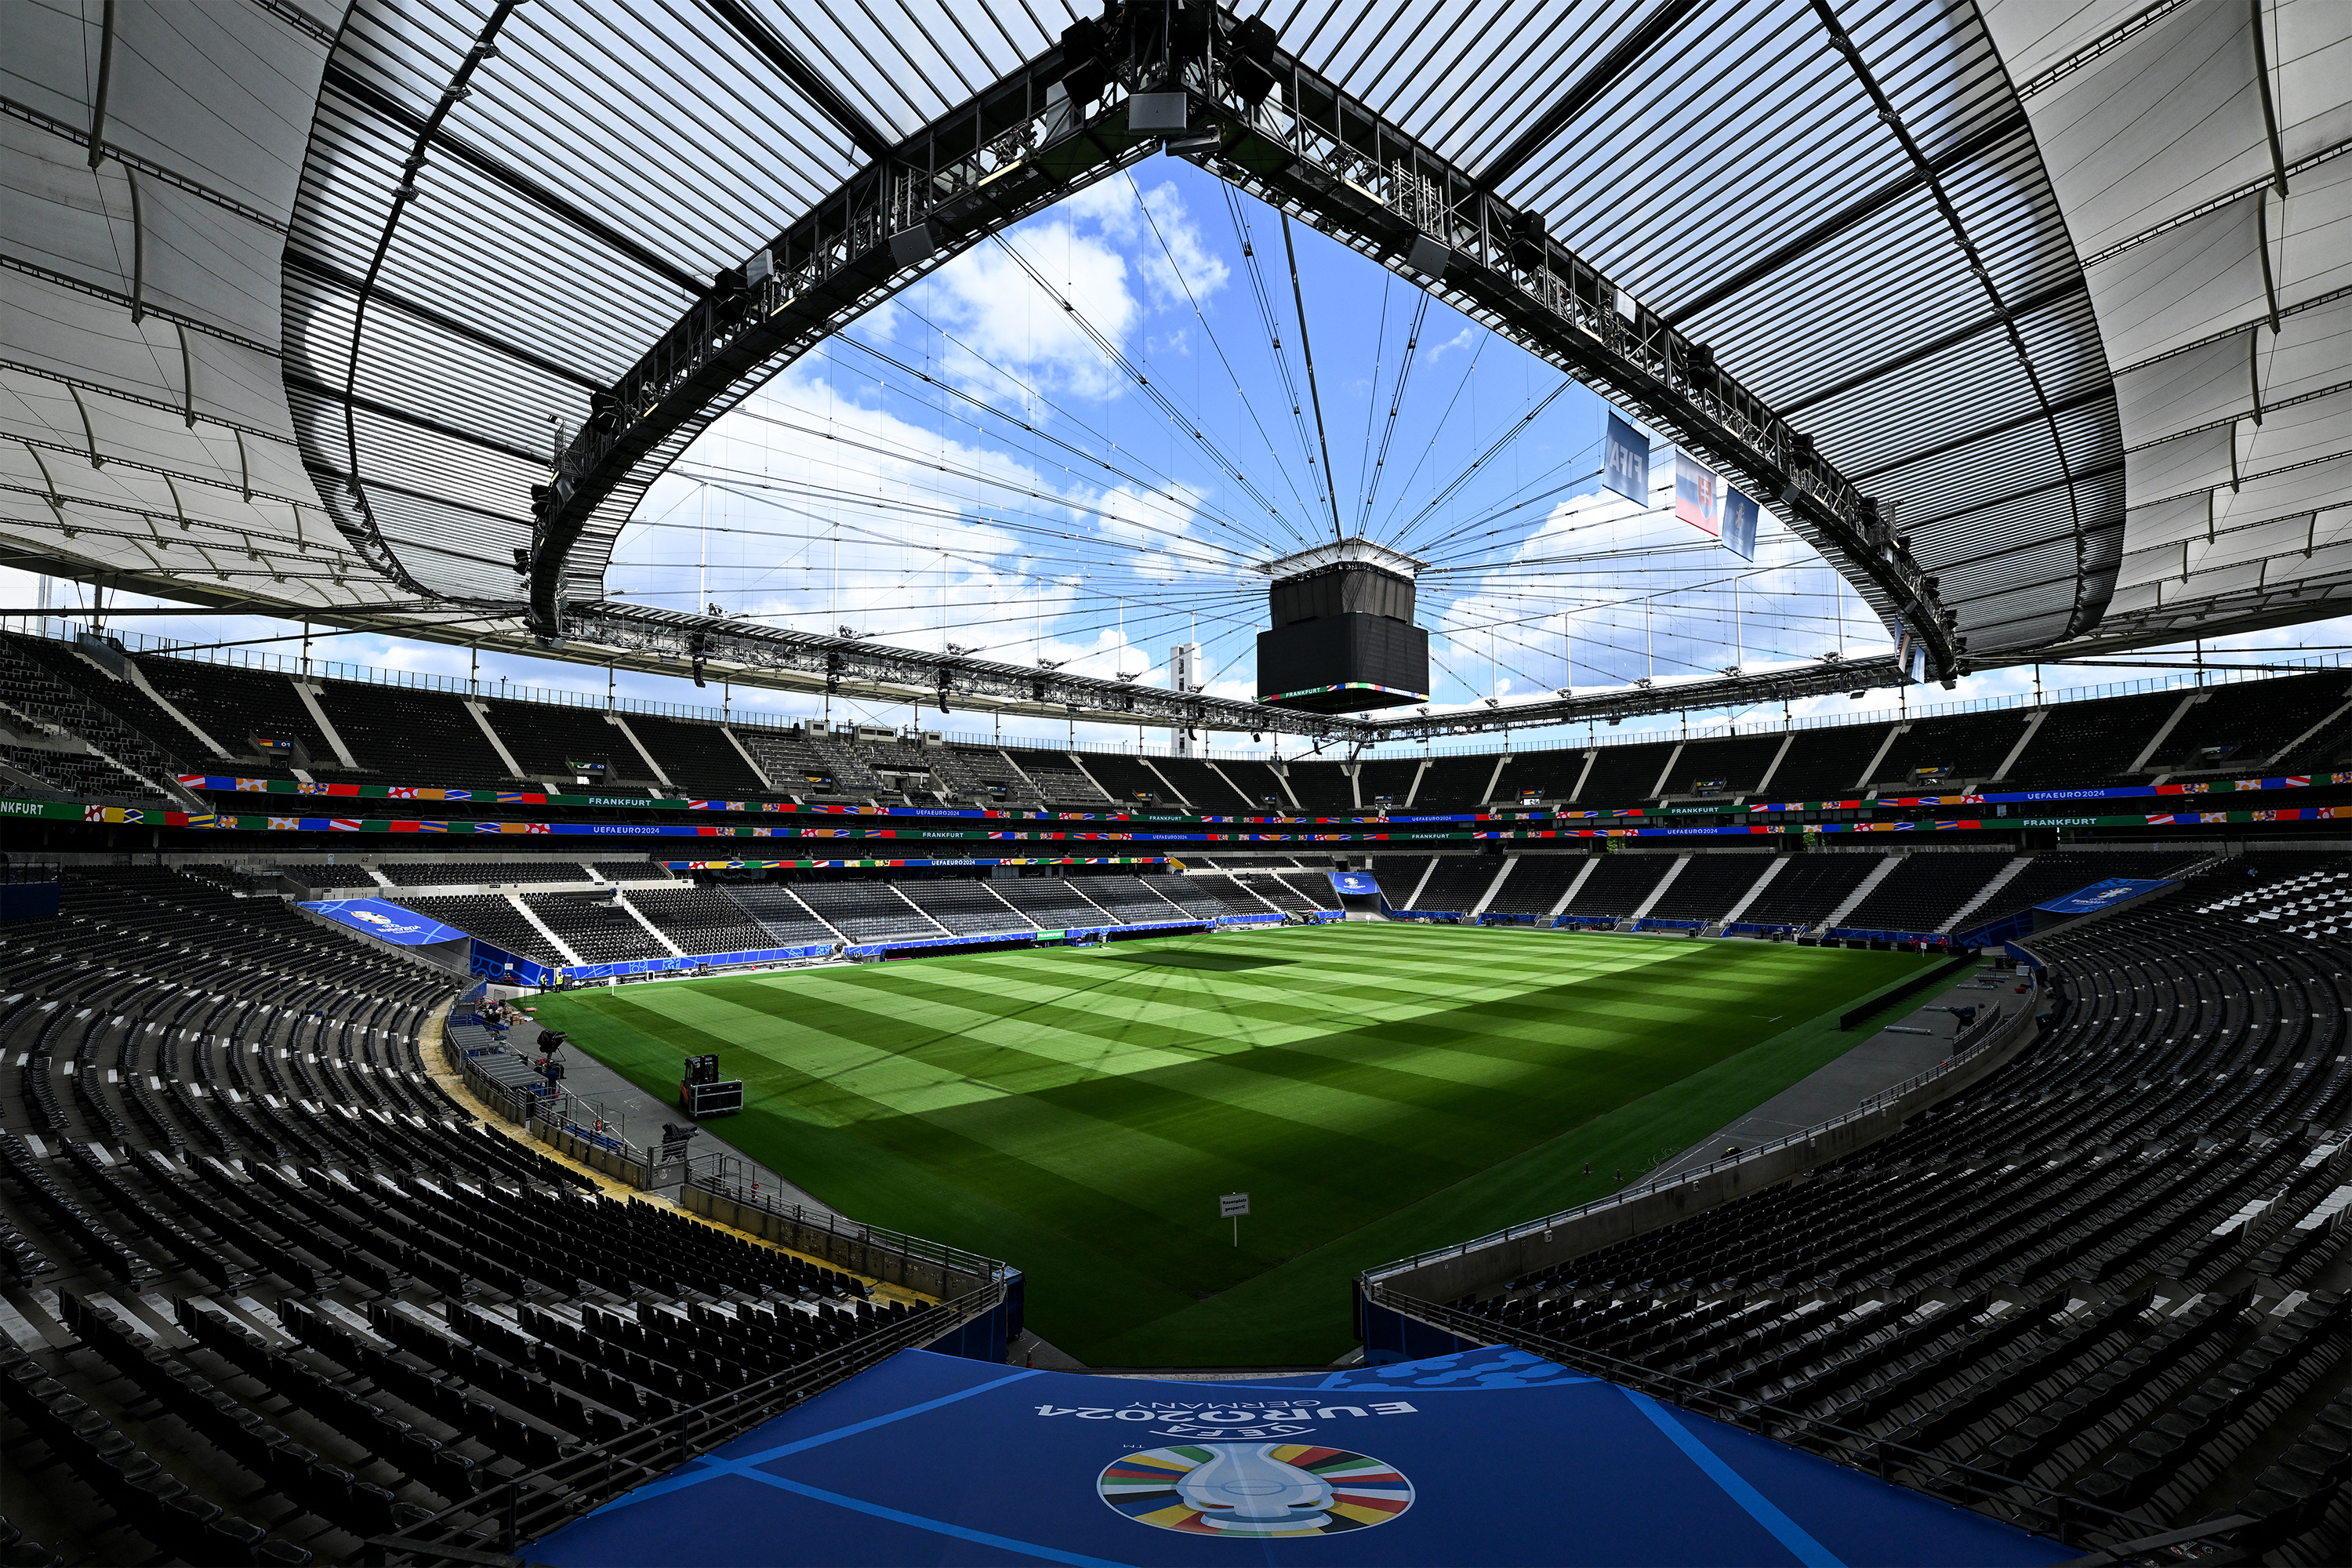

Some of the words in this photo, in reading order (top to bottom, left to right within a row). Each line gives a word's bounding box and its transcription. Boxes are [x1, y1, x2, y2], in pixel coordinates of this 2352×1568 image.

[1286, 687, 1321, 698] FRANKFURT
[0, 800, 44, 815] NKFURT
[589, 797, 652, 807] FRANKFURT
[2023, 818, 2097, 827] FRANKFURT
[1126, 1399, 1321, 1409] GERMANY
[1034, 1401, 1419, 1422] EURO2024
[1167, 1425, 1306, 1437] UEFA
